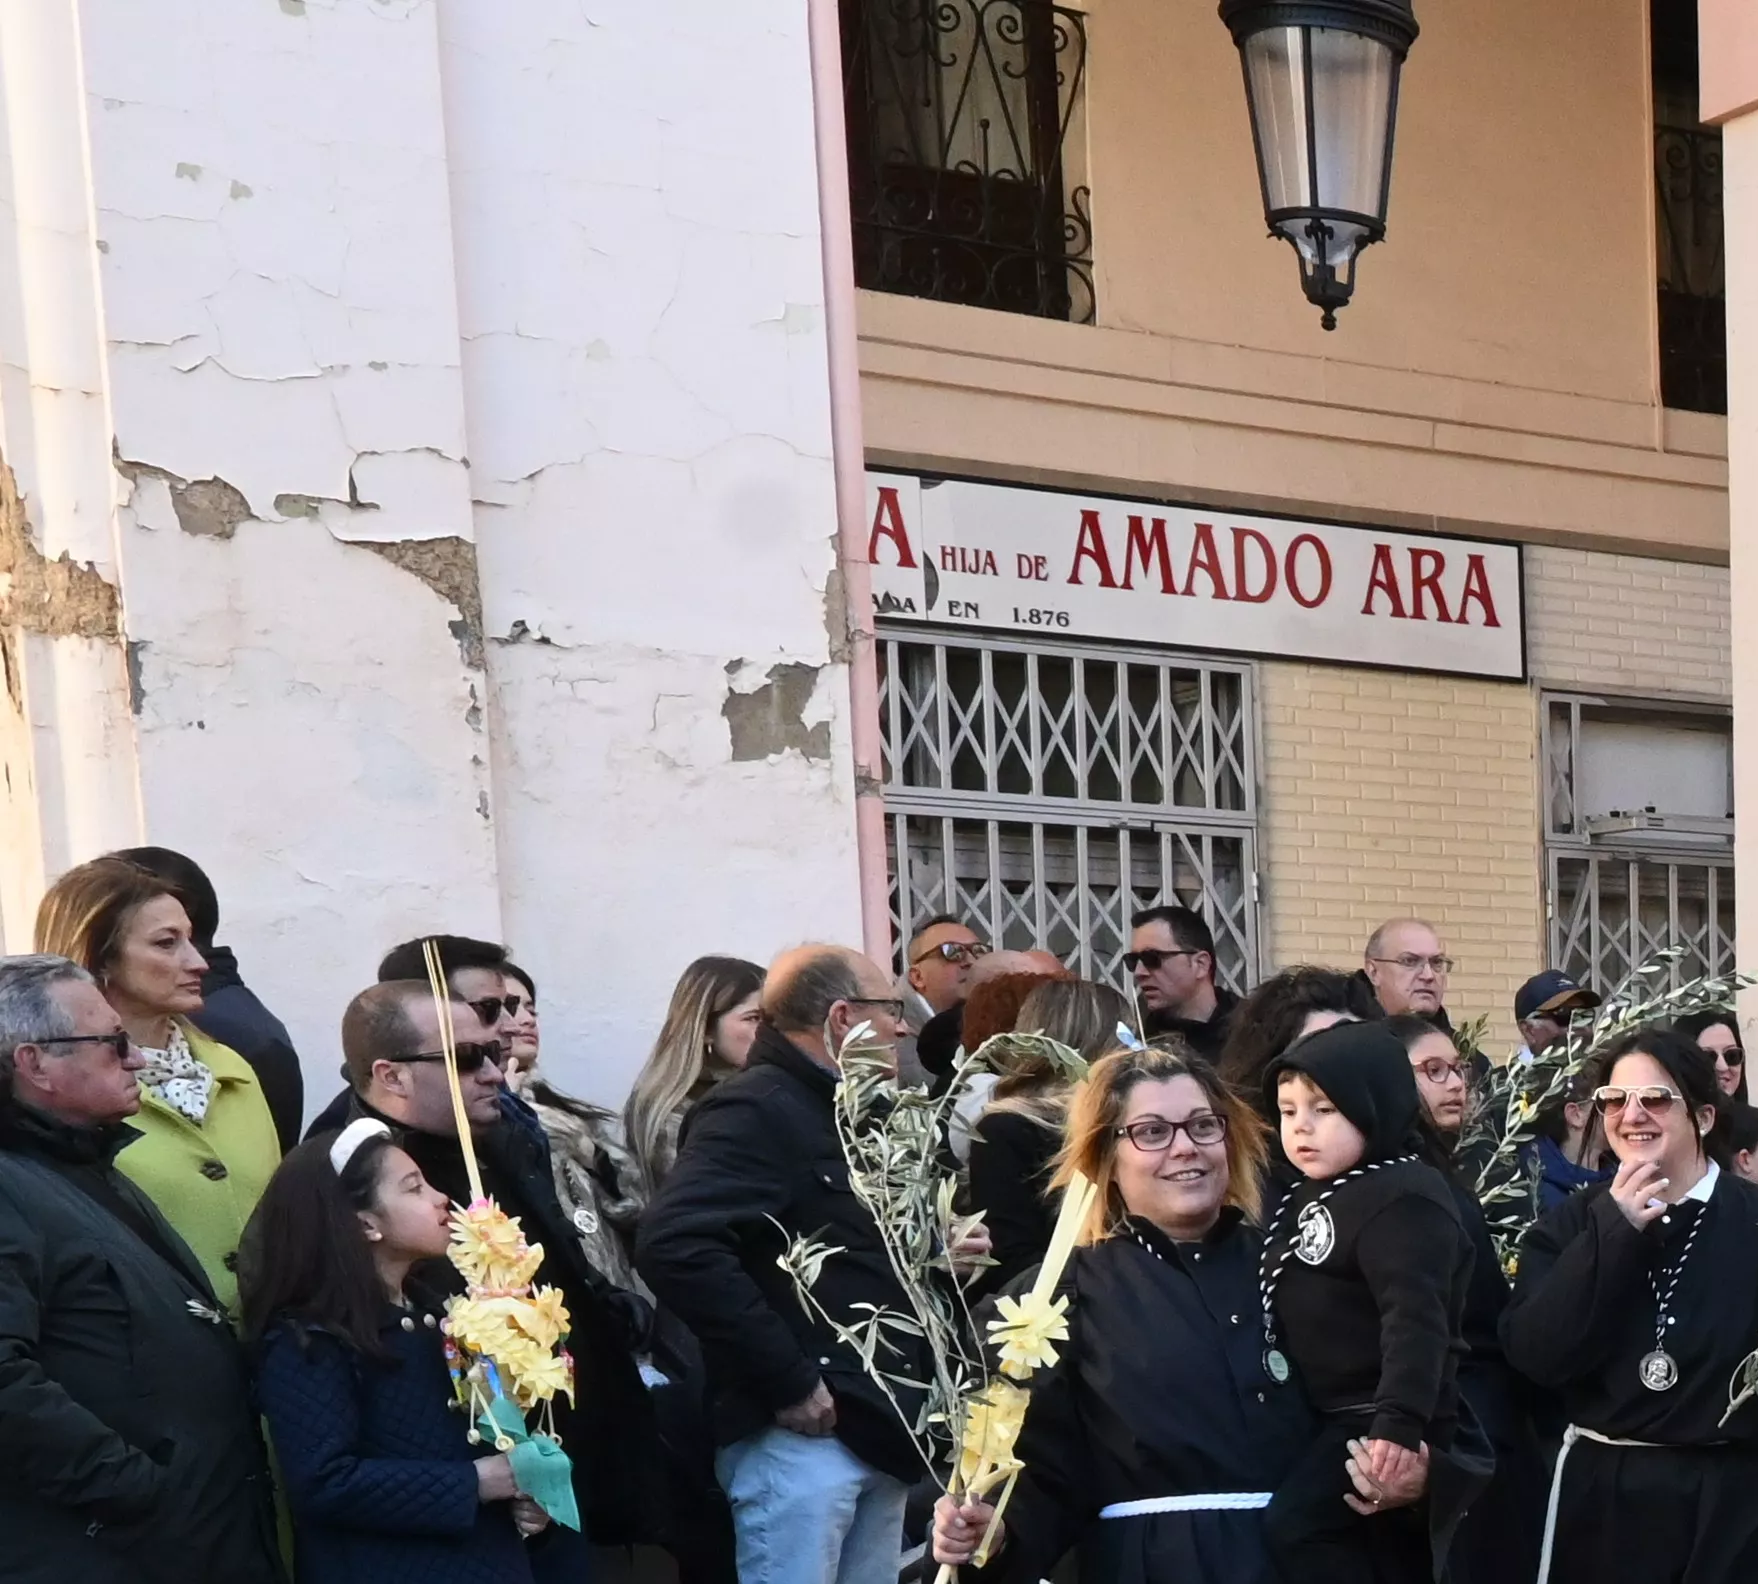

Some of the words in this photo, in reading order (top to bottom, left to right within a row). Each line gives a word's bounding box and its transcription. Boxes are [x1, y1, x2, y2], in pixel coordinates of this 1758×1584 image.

[940, 545, 999, 577] HIJA
[1016, 552, 1049, 582] DE
[1066, 509, 1332, 609] AMADO
[1361, 543, 1502, 628] ARA
[948, 600, 980, 619] EN
[1012, 607, 1070, 628] 1.876
